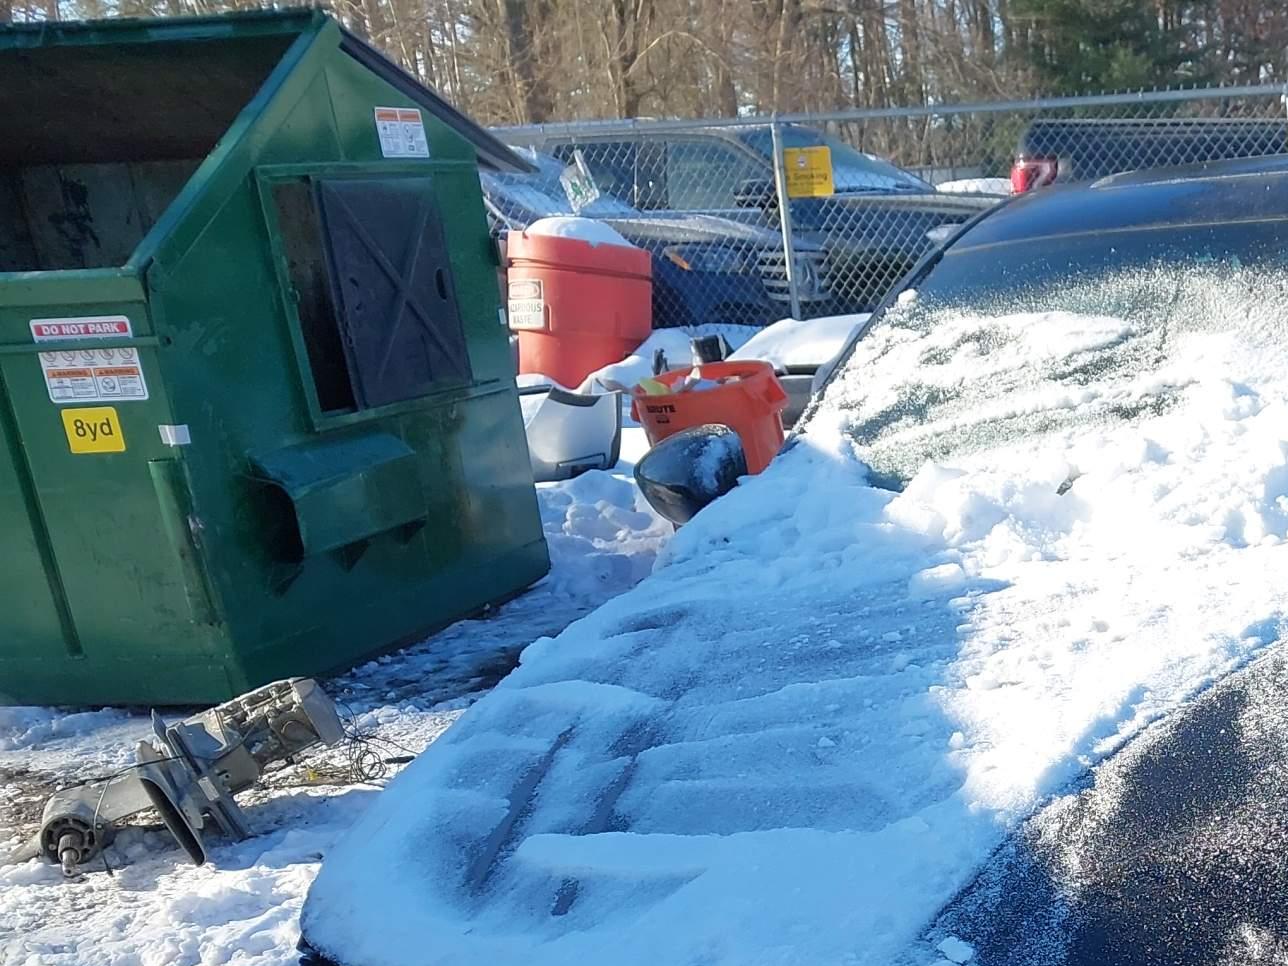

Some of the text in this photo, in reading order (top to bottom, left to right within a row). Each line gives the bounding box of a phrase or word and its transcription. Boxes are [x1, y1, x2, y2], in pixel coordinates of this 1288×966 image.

[509, 303, 542, 313] ZARDOUS
[41, 322, 120, 335] DO NOT PARK
[73, 417, 114, 442] 8yd
